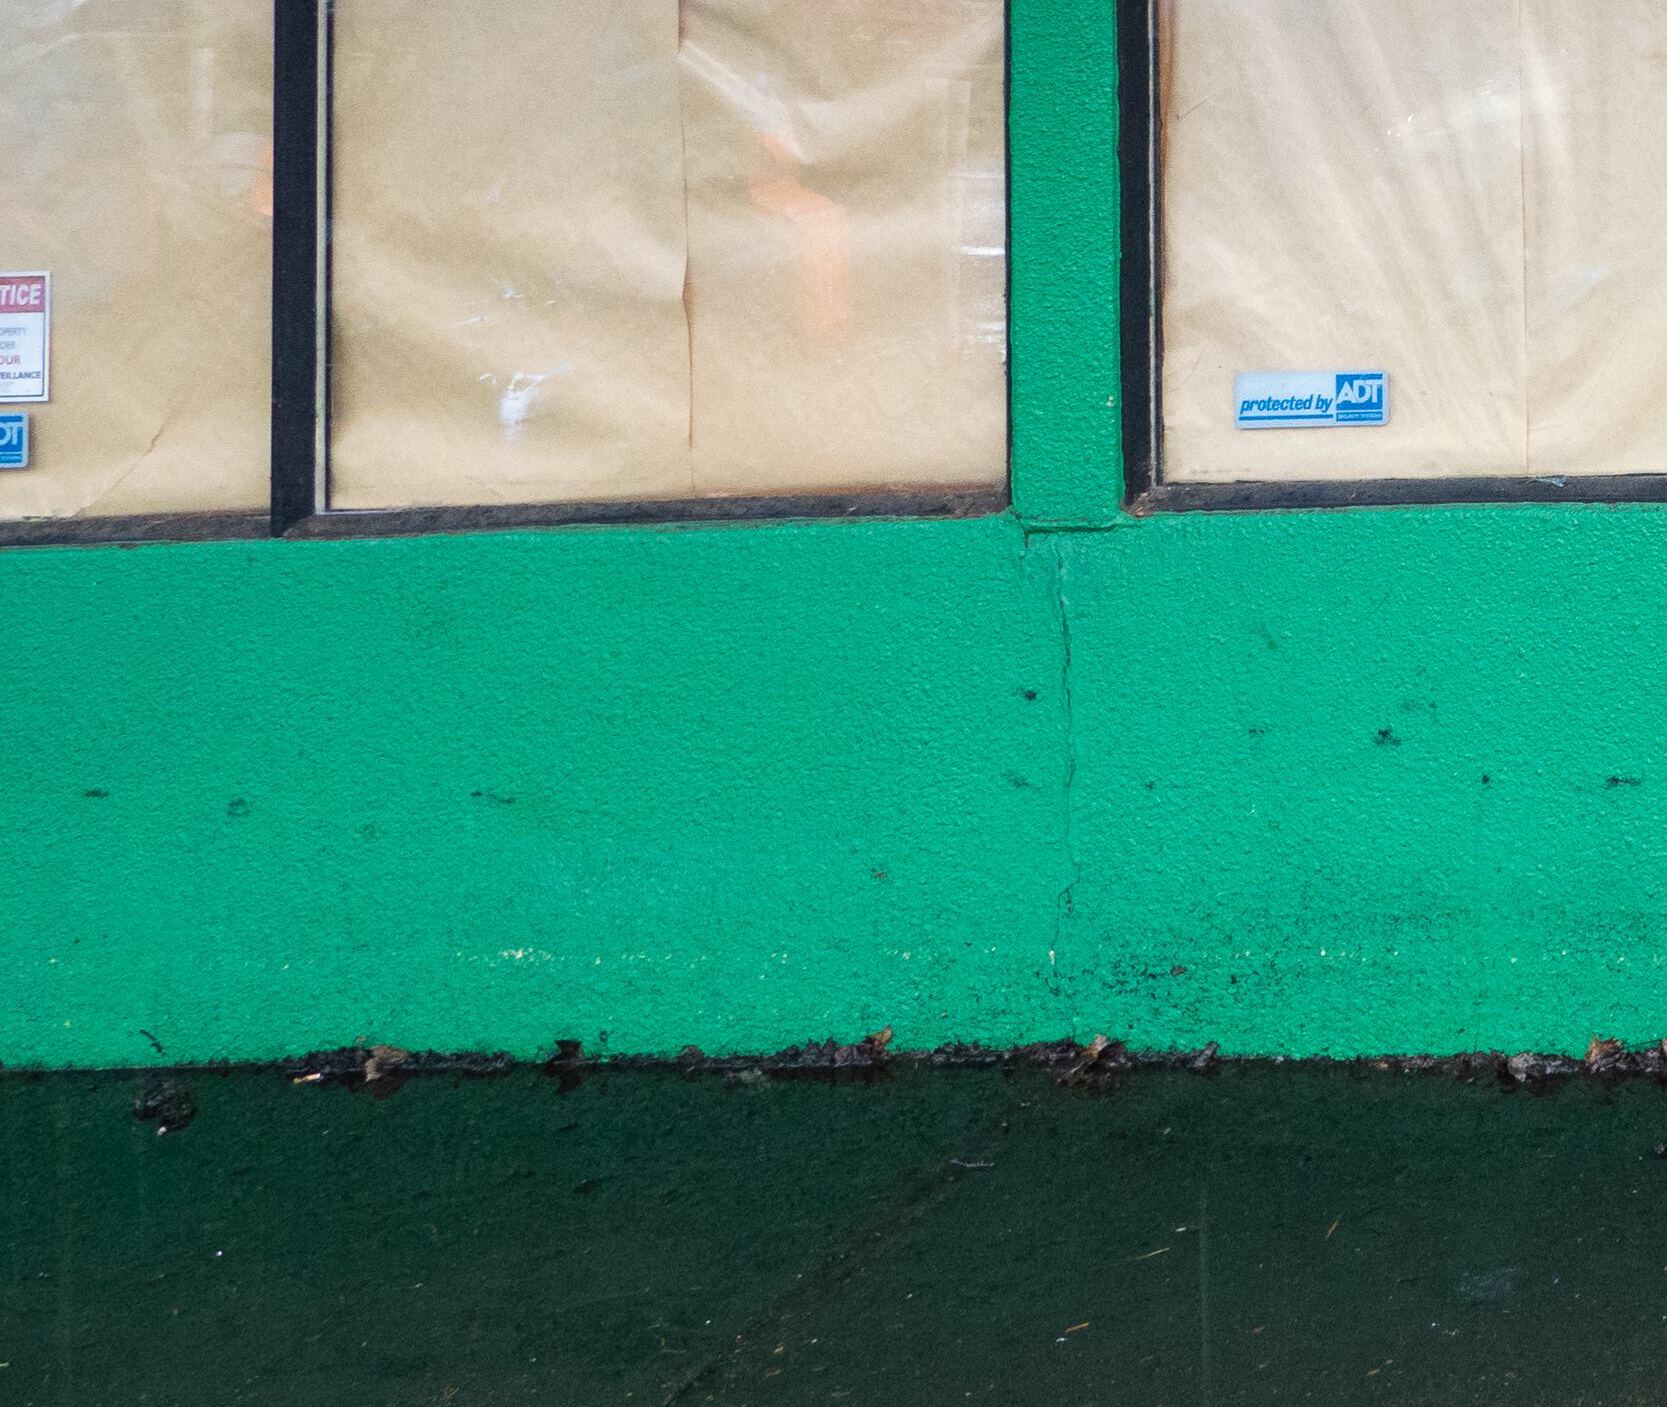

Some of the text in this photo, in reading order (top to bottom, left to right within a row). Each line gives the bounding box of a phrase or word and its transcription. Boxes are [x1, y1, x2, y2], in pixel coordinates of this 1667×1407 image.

[1240, 379, 1383, 415] protected by ADT
